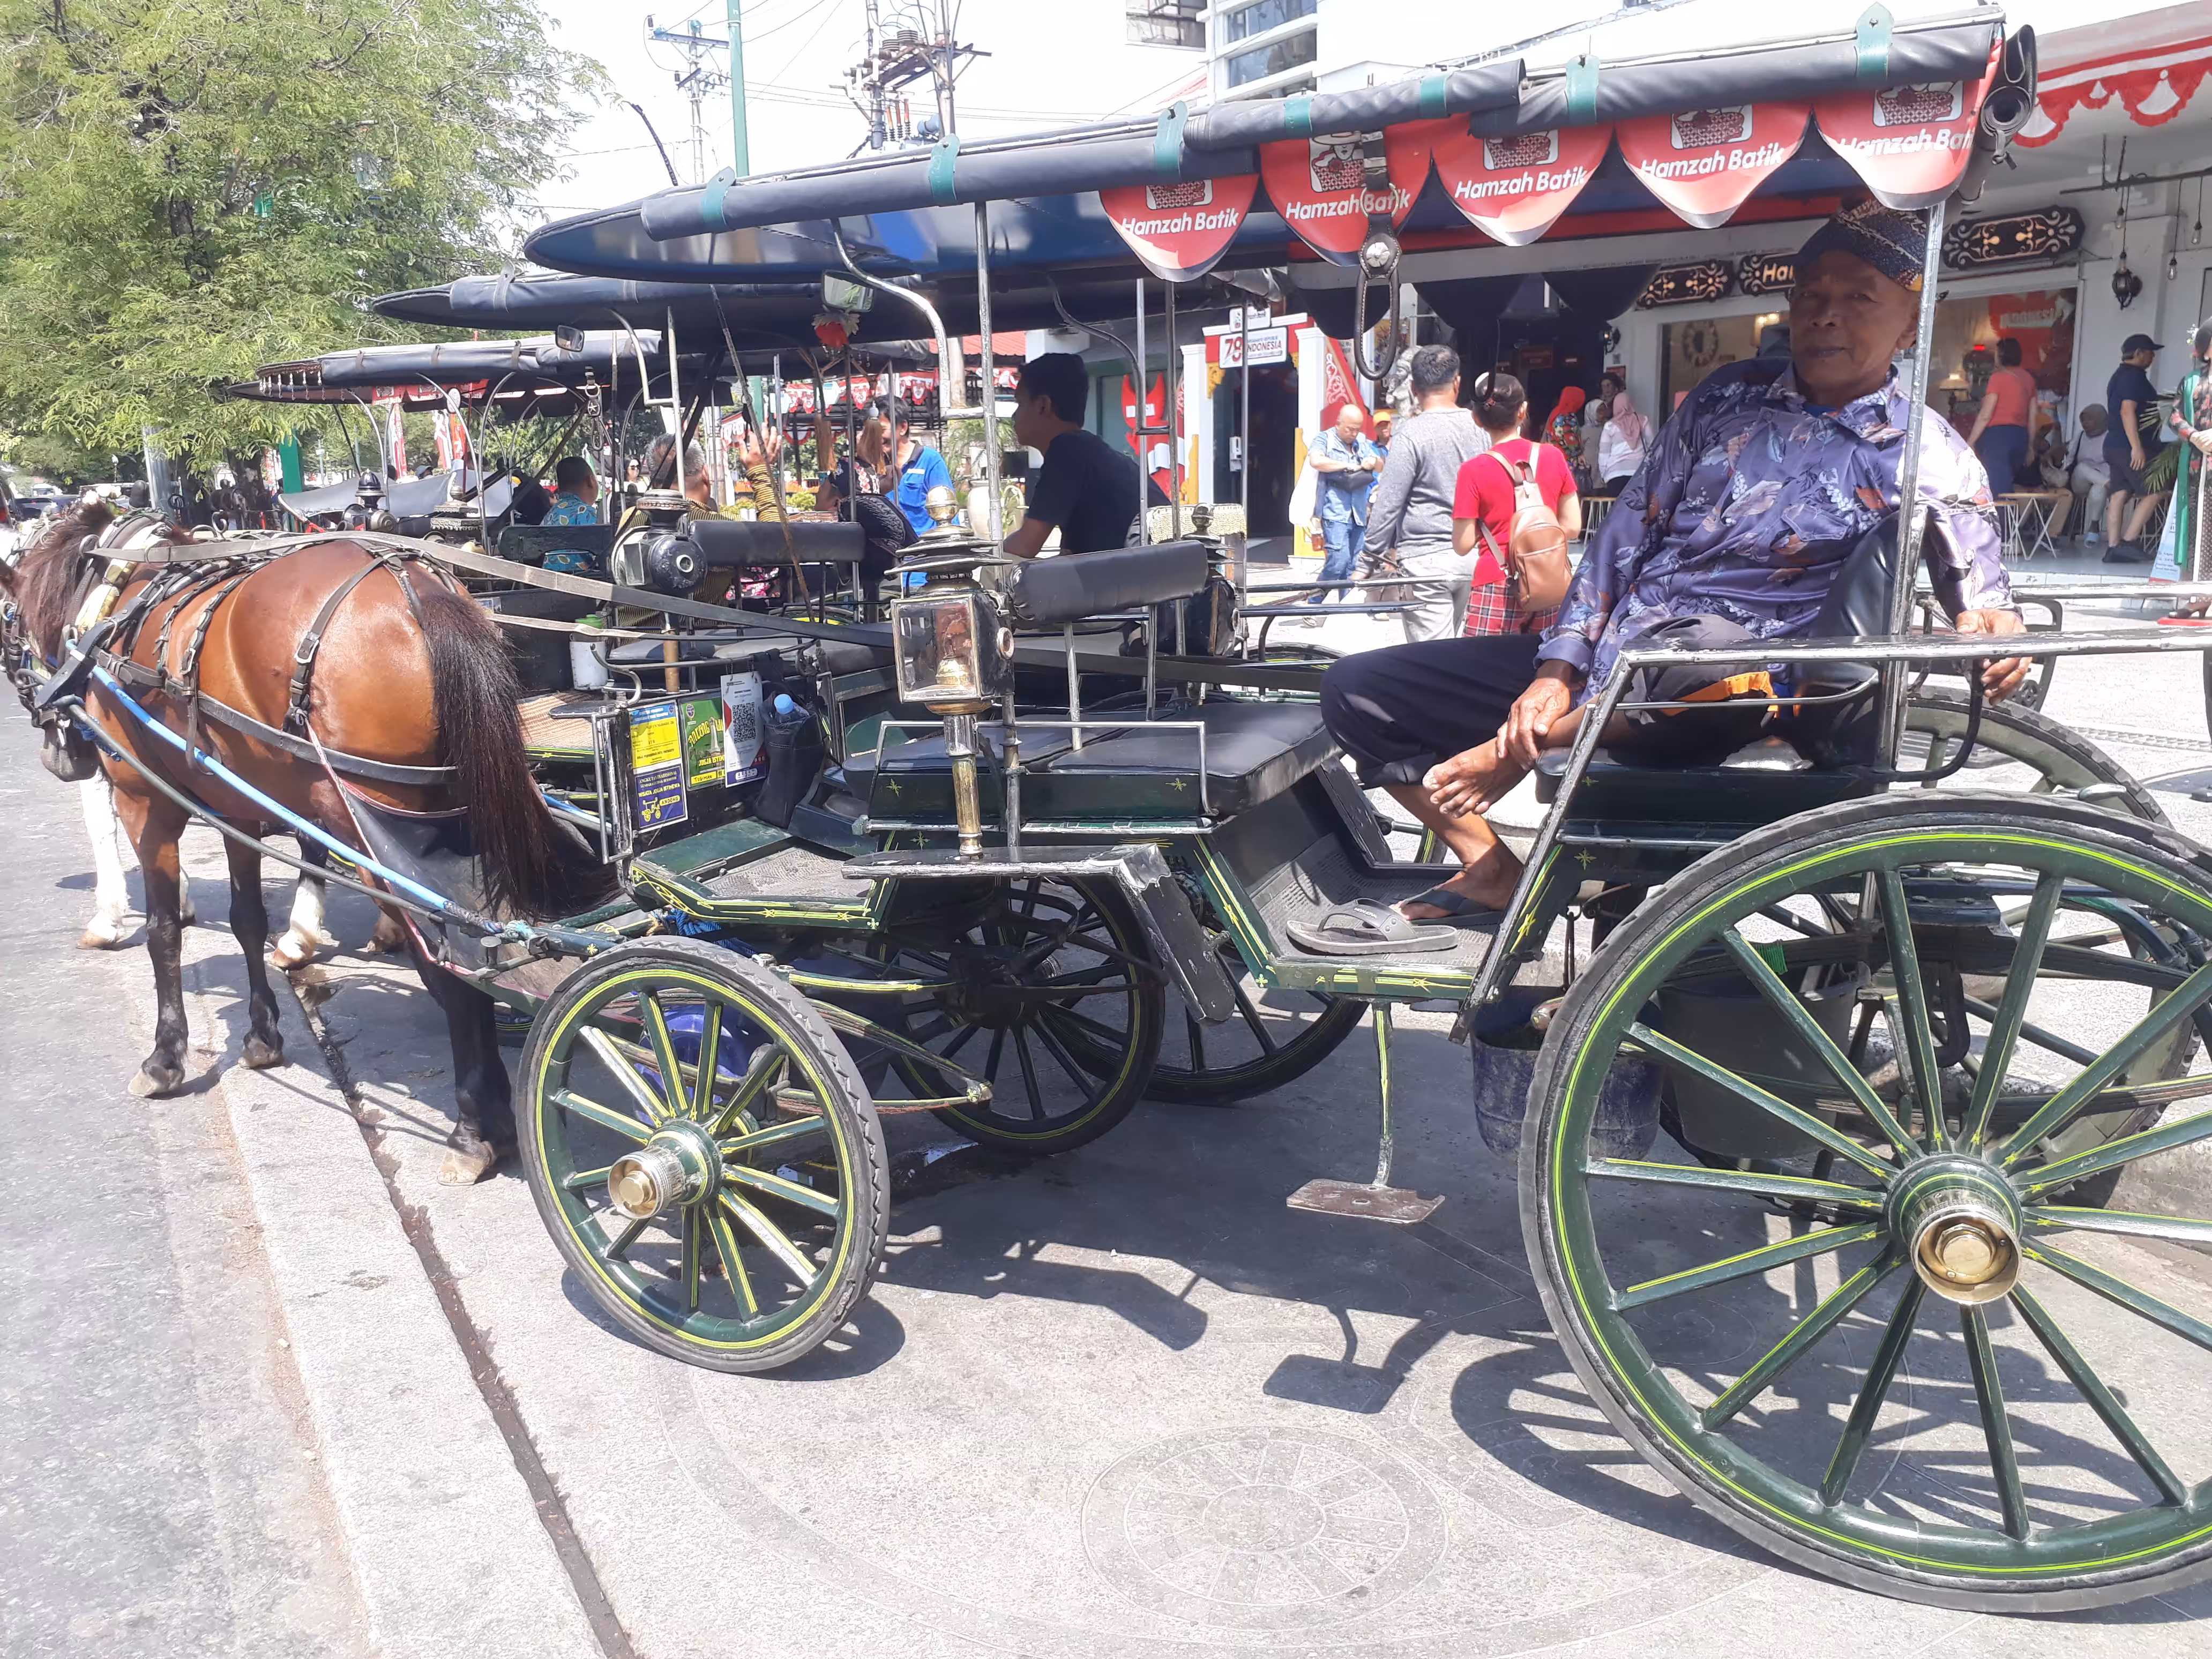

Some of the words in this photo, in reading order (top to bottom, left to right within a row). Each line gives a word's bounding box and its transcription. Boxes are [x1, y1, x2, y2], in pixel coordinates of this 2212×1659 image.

[1641, 150, 1725, 178] Hamzah
[1728, 142, 1784, 170] Batik
[1454, 171, 1534, 199] Hamzah
[1536, 166, 1587, 192] Batik
[1286, 194, 1359, 220] Hamzah
[1364, 189, 1411, 212] Batik
[1120, 212, 1191, 235] Hamzah
[1194, 208, 1239, 231] Batik
[1225, 337, 1243, 362] 78
[1247, 340, 1282, 352] NDONESIA
[661, 797, 678, 805] ANDONG
